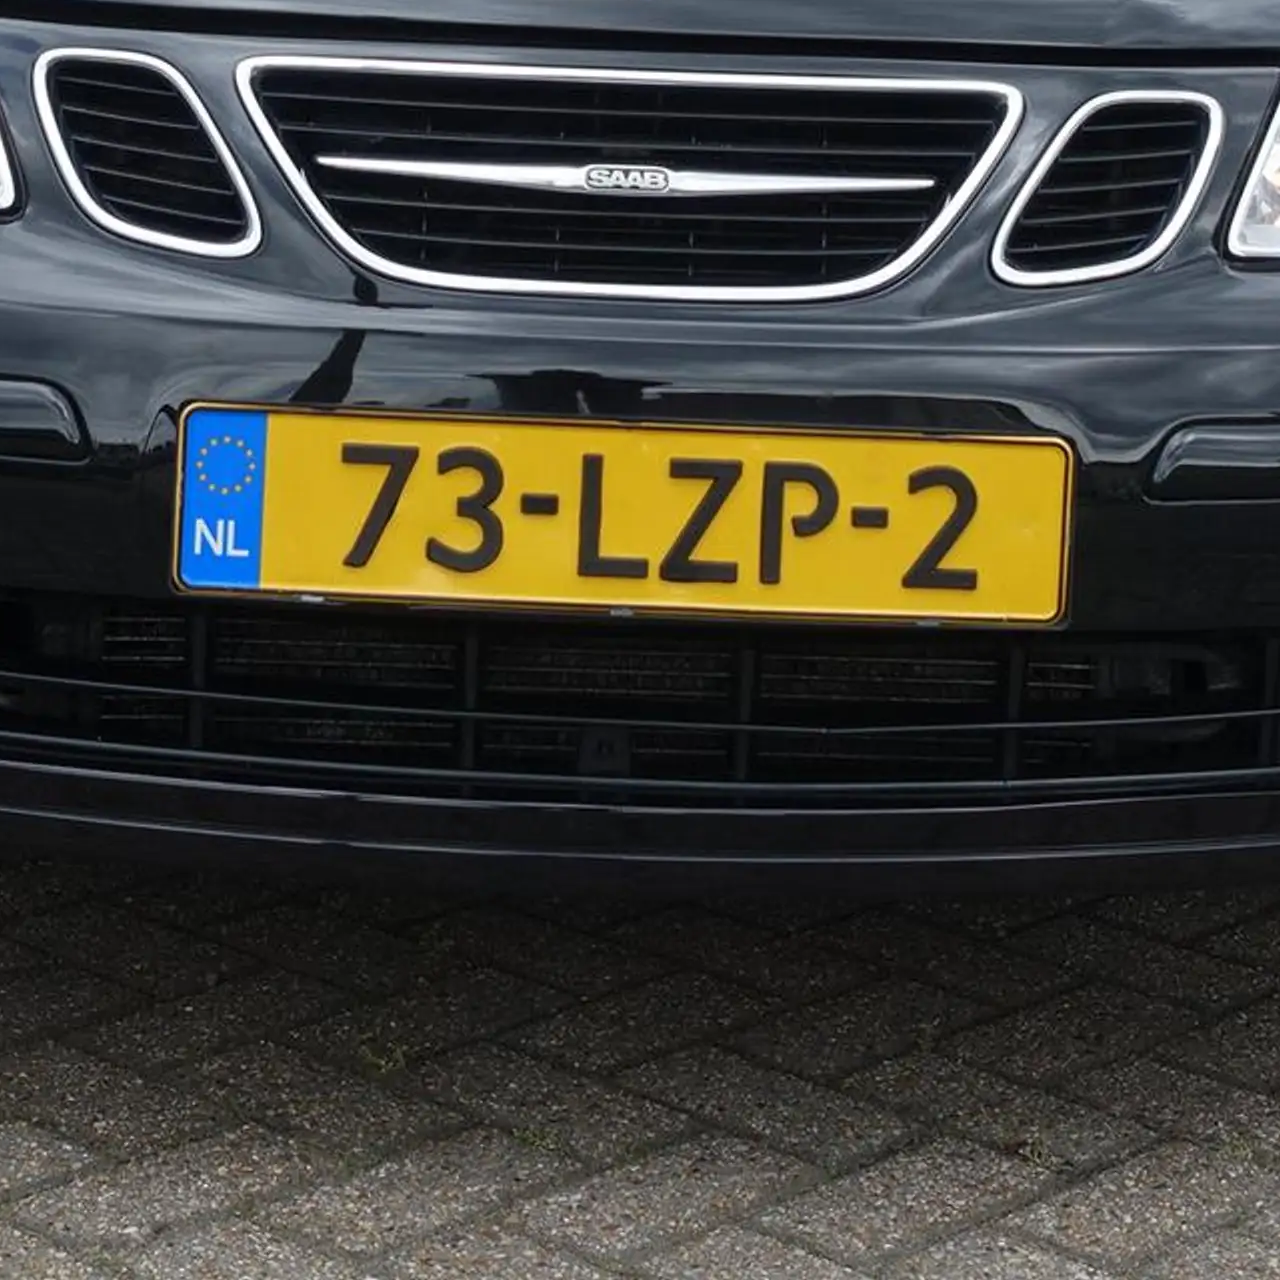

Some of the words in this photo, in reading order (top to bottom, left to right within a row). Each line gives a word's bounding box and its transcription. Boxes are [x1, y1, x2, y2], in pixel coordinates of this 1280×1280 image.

[588, 168, 666, 190] SAAB
[341, 442, 978, 590] 73-LZP-2
[193, 517, 250, 558] NL
